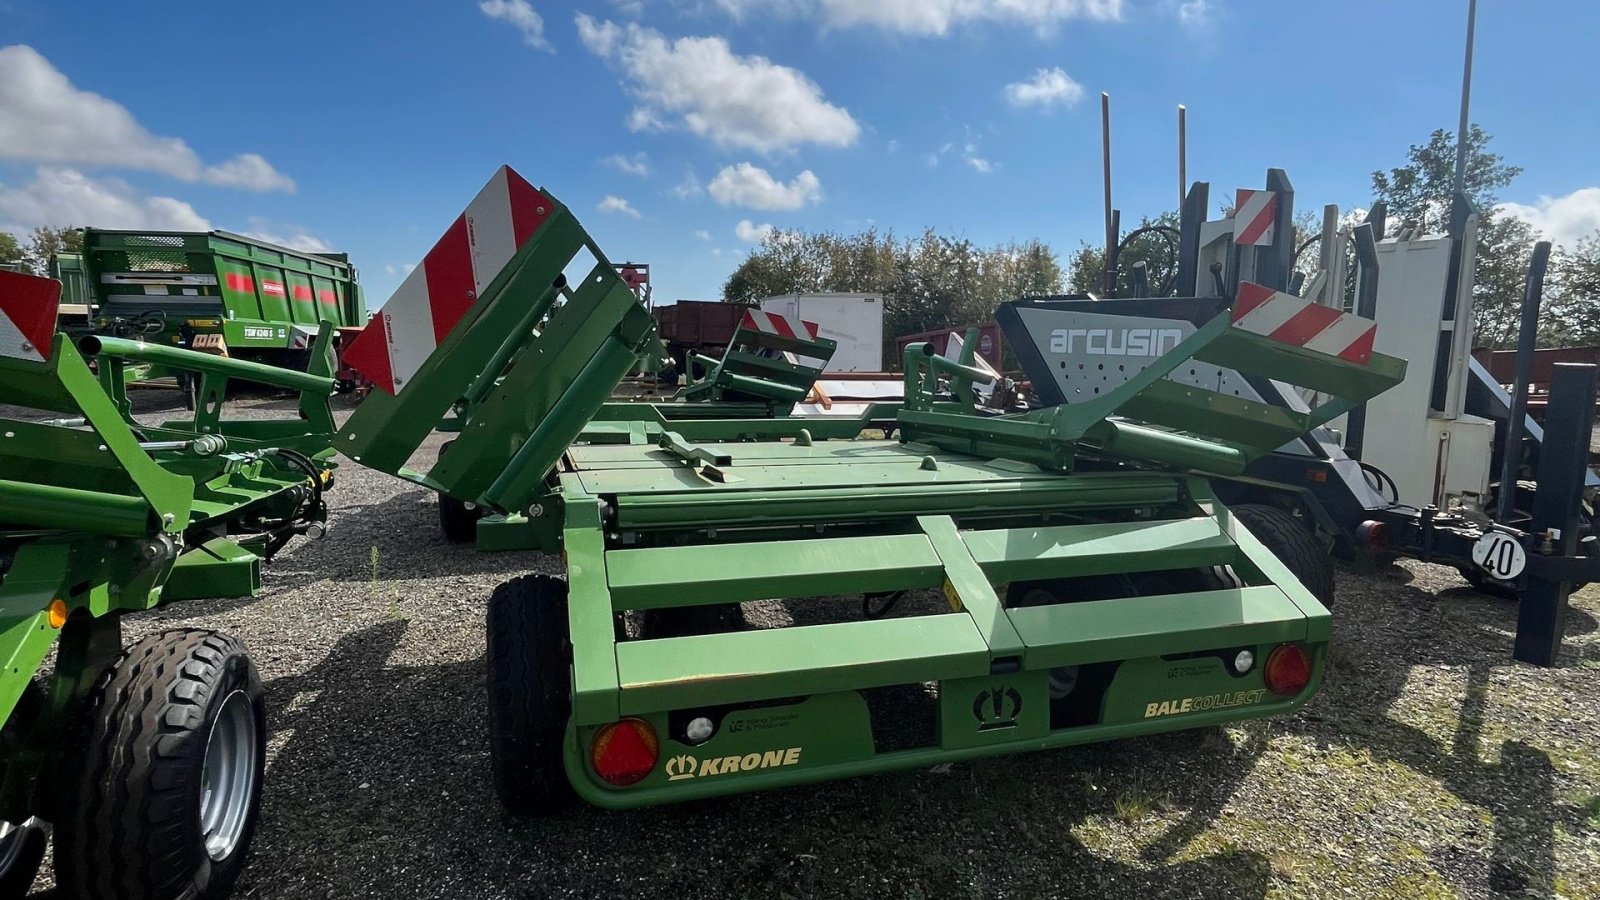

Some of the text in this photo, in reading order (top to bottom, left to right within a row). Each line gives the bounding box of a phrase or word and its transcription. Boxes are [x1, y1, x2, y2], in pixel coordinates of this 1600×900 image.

[1051, 329, 1181, 356] arcusin
[1482, 537, 1514, 576] 40
[699, 747, 802, 778] KRONE
